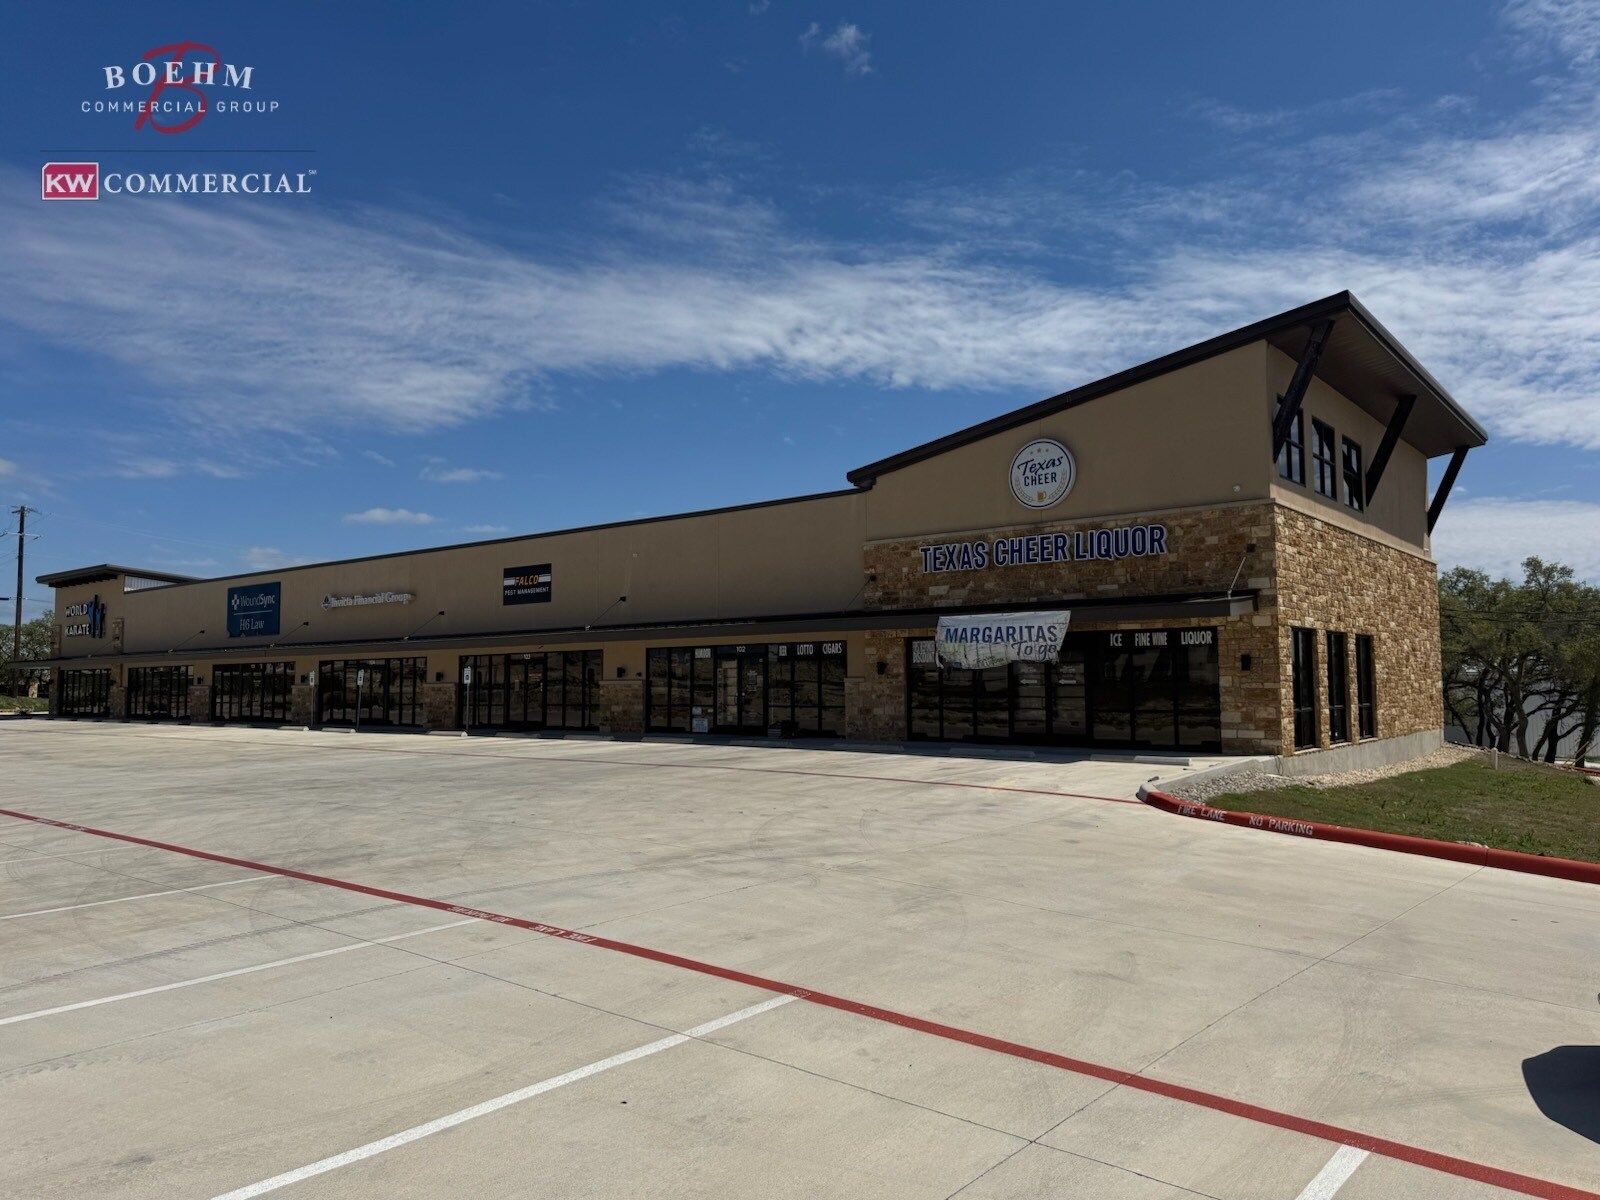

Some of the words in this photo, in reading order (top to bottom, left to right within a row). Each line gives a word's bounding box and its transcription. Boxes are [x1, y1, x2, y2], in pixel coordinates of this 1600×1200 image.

[1017, 454, 1063, 477] Texas
[1023, 471, 1057, 488] CHEER
[920, 541, 988, 574] TEXAS
[994, 533, 1070, 567] CHEER
[1074, 524, 1167, 562] LIQUOR
[514, 575, 539, 586] FALCO
[517, 586, 549, 595] MANAGEMENT
[240, 593, 275, 608] WoundSync
[353, 593, 384, 606] Financial
[385, 592, 411, 605] Group
[64, 604, 88, 618] WORLD
[64, 623, 90, 637] KARATE
[251, 618, 265, 630] Law
[945, 625, 1058, 644] MARGARITAS
[1110, 633, 1122, 647] ICE
[1135, 633, 1150, 647] FINE
[1152, 632, 1167, 646] WINE
[1181, 631, 1212, 645] LIQUOR
[796, 644, 814, 656] LOTTO
[822, 642, 843, 655] CIGARS
[1011, 640, 1033, 657] To
[1038, 645, 1057, 660] go
[1178, 804, 1196, 815] FIRE
[1201, 808, 1225, 821] LANE
[1249, 816, 1263, 827] NO
[1268, 818, 1314, 836] PARKING
